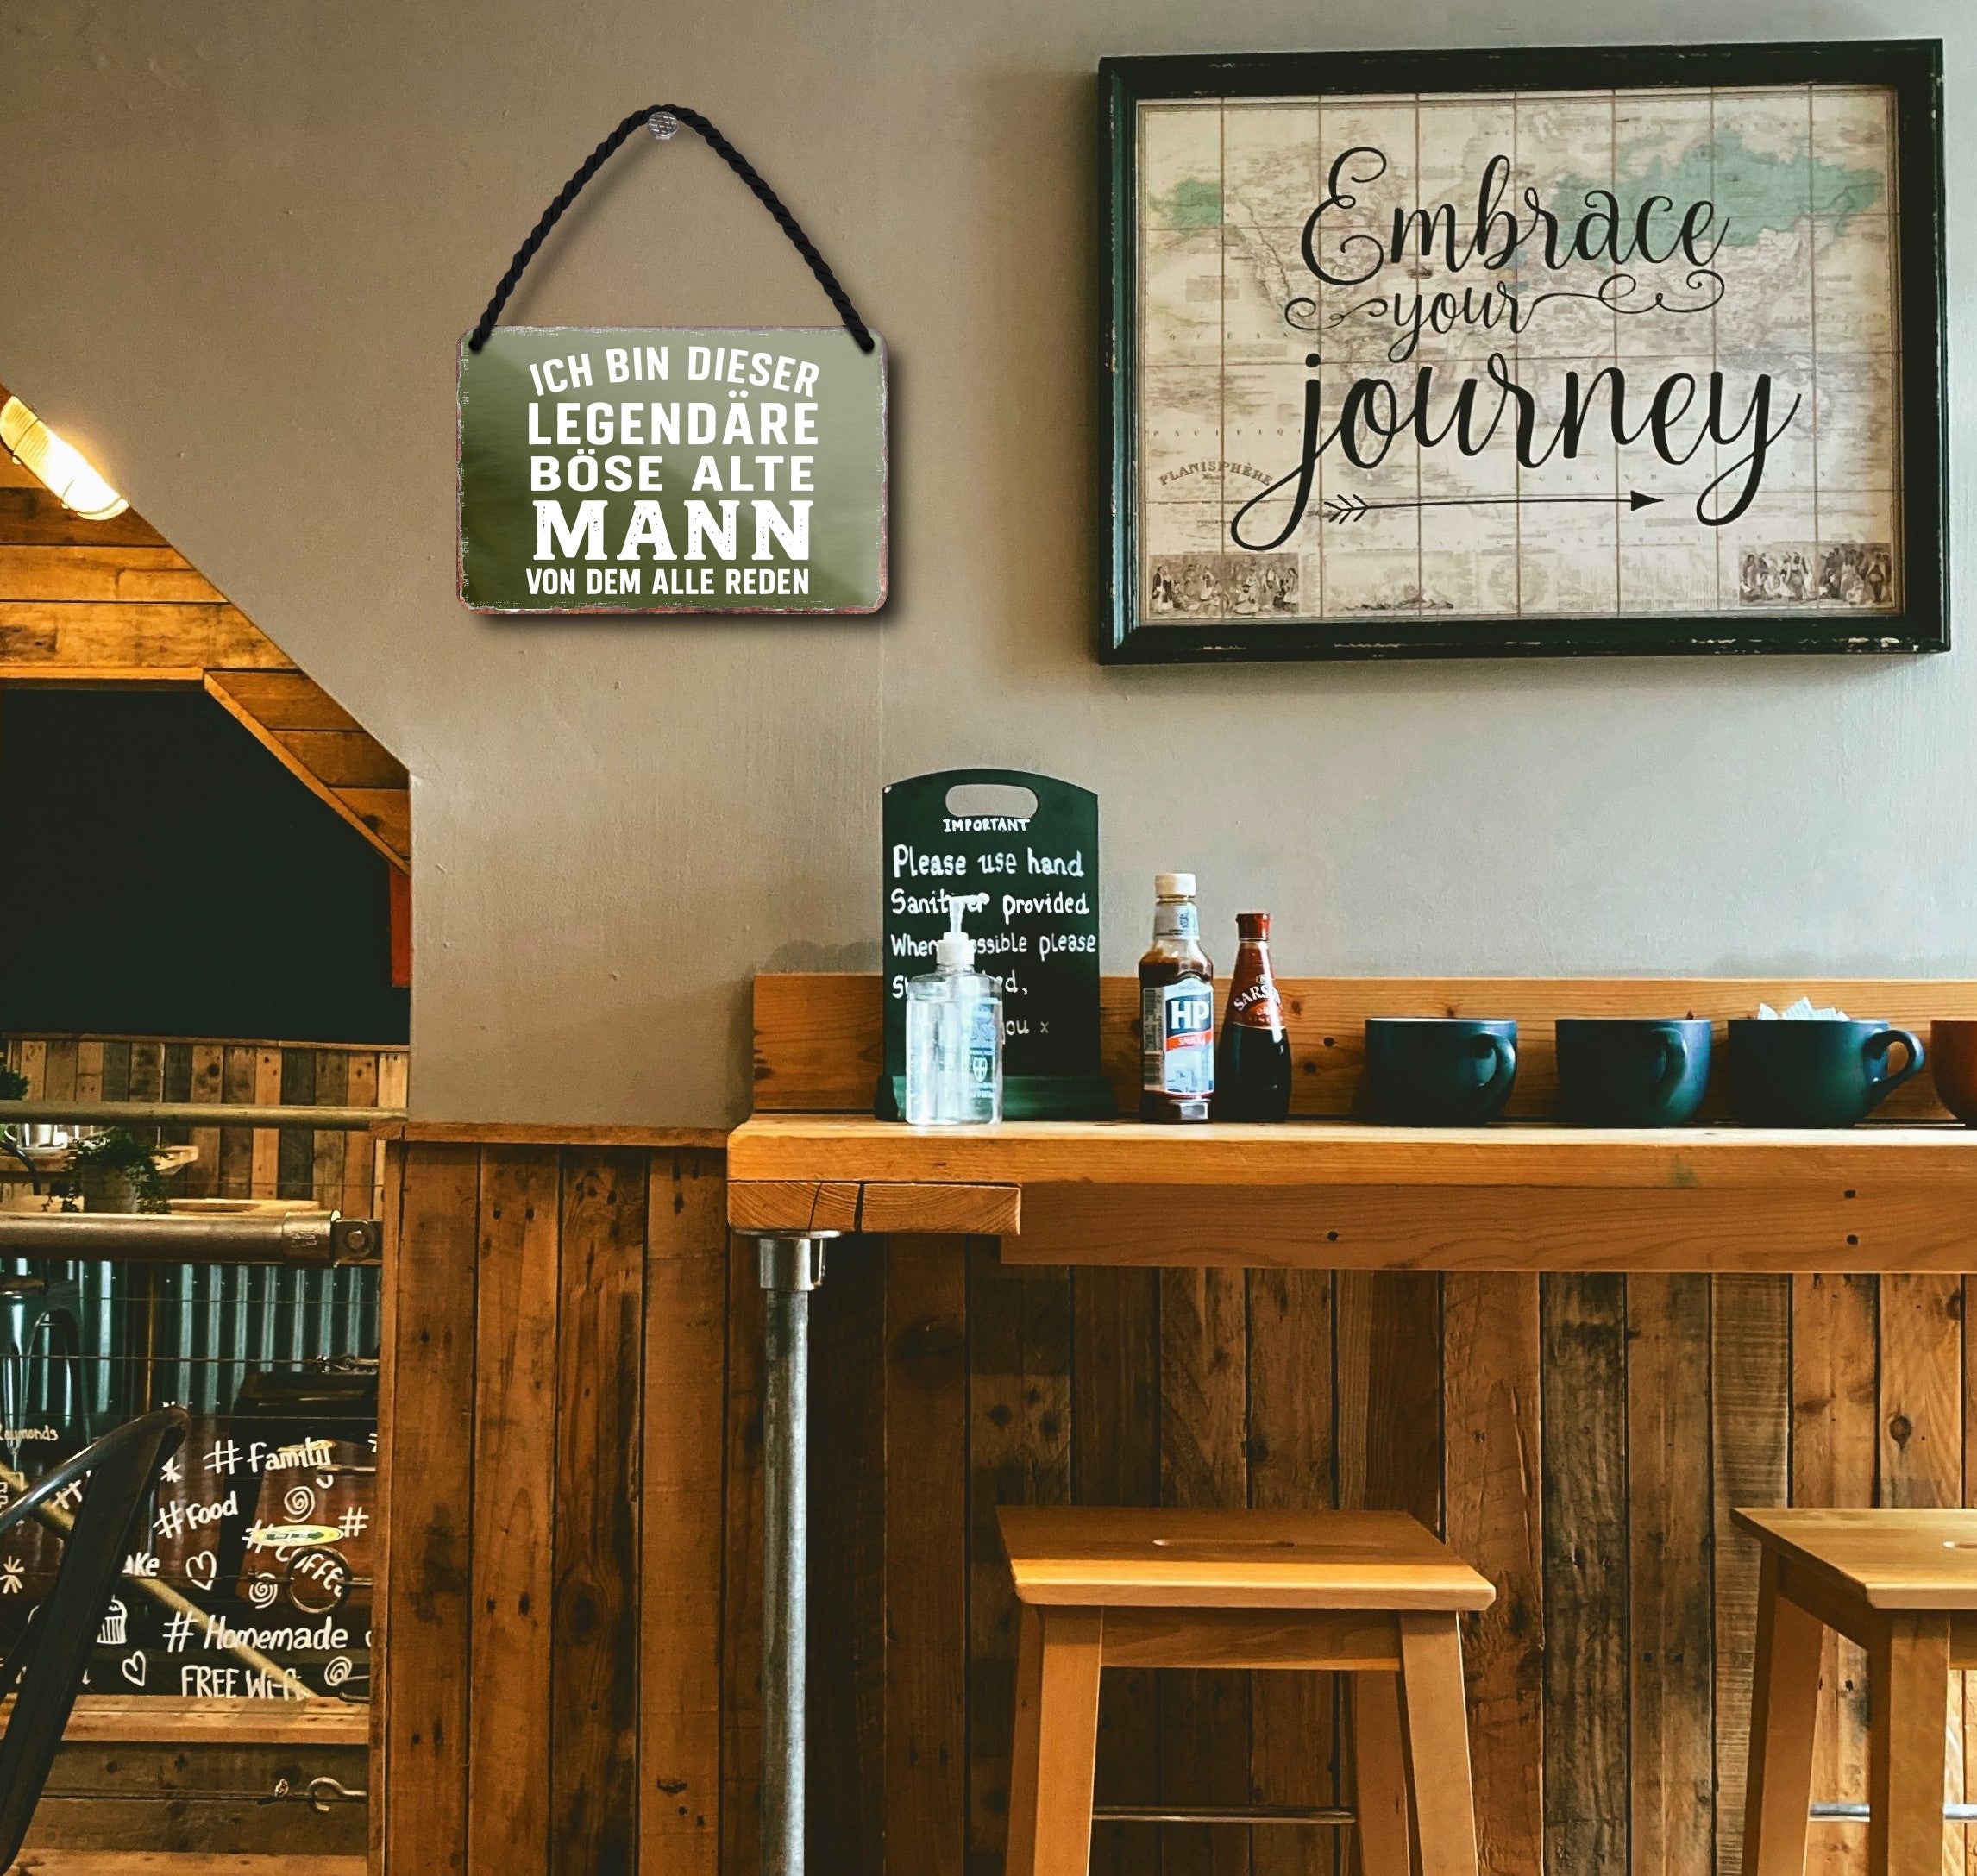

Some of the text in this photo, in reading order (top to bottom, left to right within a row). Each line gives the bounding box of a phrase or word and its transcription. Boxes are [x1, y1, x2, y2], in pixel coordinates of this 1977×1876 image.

[1300, 146, 1729, 286] Embrace
[529, 345, 820, 398] ICH BIN DIESER
[527, 390, 819, 446] LEGENDÄRE
[1230, 352, 1803, 552] journey
[530, 448, 815, 492] BÖSE ALTE
[532, 499, 814, 562] MANN
[525, 568, 809, 595] VON DEM ALLE REDEN
[942, 817, 1031, 833] IMPORTANT
[893, 844, 1085, 878] Please use hand
[1002, 890, 1090, 925] provided
[970, 932, 1027, 955] ssible
[1039, 932, 1096, 962] please
[1170, 999, 1210, 1029] HP
[180, 1665, 240, 1699] FREE
